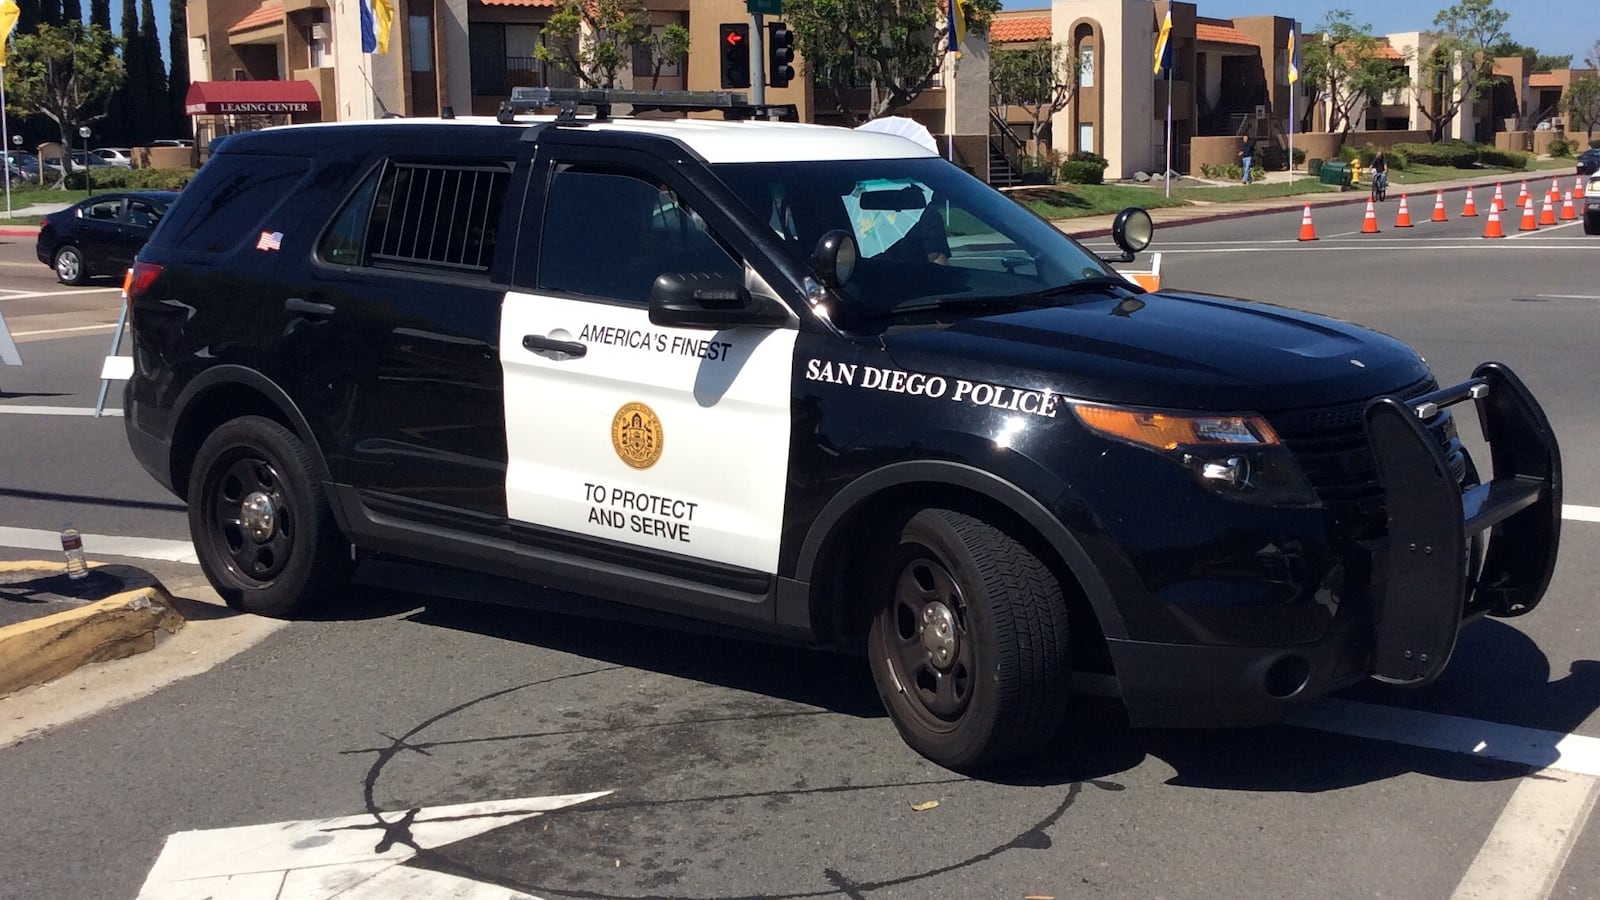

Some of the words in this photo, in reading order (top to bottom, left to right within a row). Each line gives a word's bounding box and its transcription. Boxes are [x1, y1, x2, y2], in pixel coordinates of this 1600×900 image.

[220, 103, 266, 112] LEASING
[267, 103, 308, 112] CENTER
[579, 324, 667, 352] AMERICA'S
[671, 336, 732, 362] FINEST
[806, 358, 857, 386] SAN
[860, 366, 947, 398] DIEGO
[951, 379, 1059, 418] POLICE
[584, 482, 606, 503] TO
[611, 488, 698, 521] PROTECT
[588, 507, 625, 529] AND
[630, 514, 691, 543] SERVE
